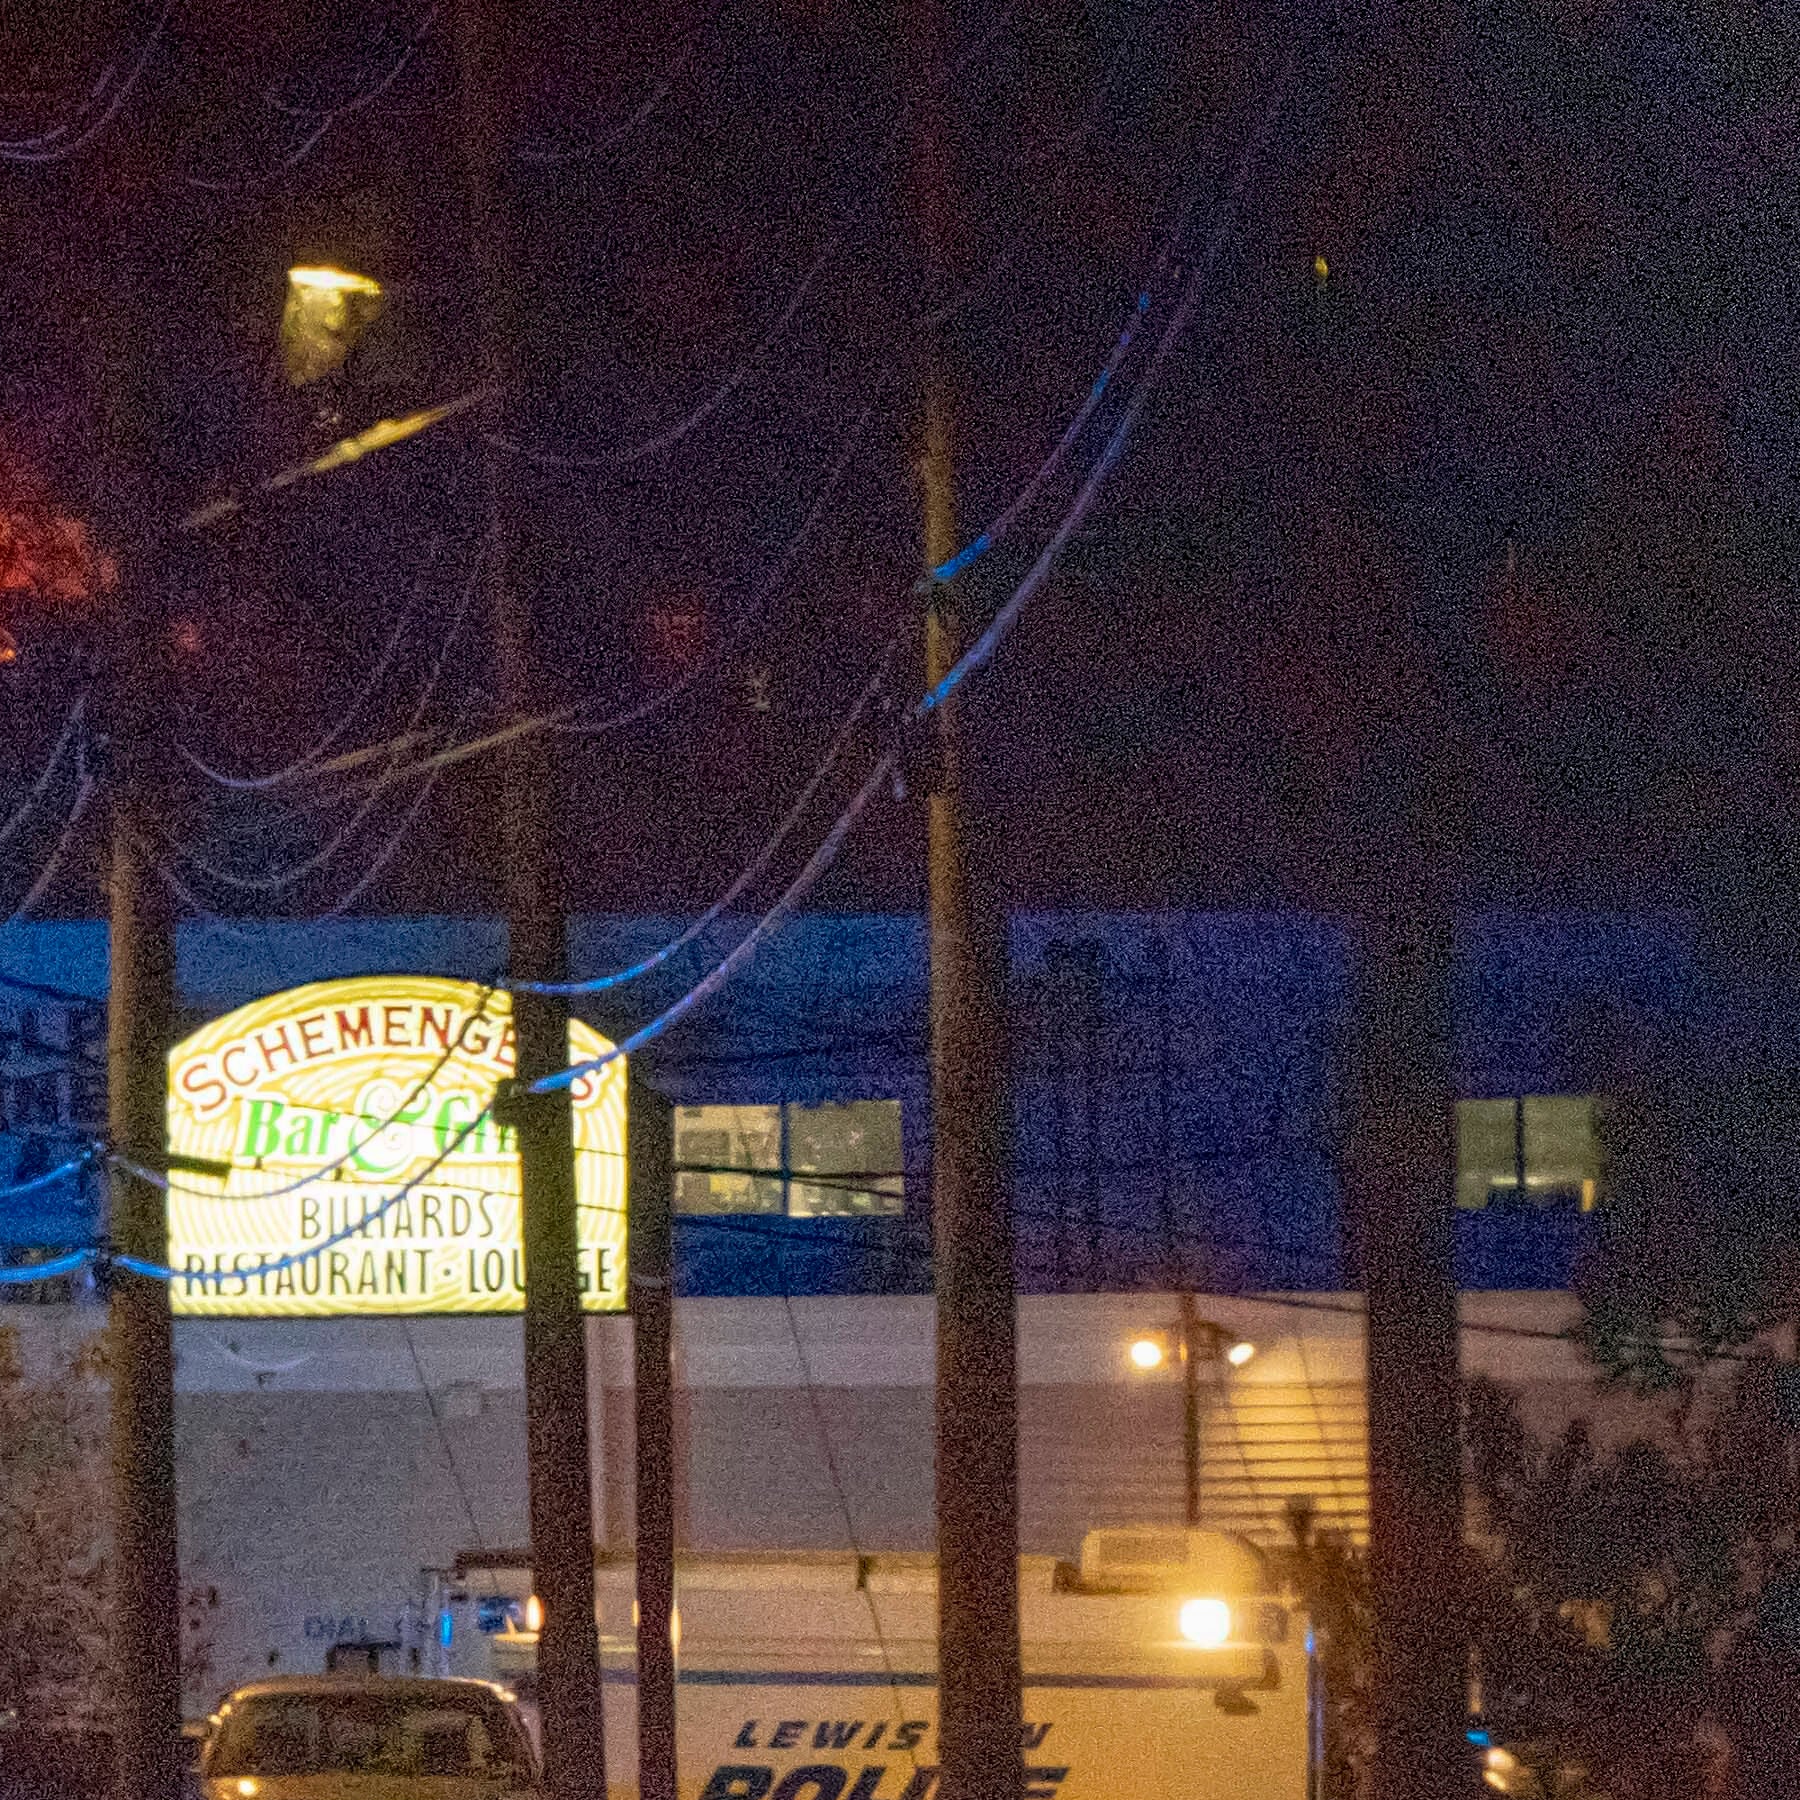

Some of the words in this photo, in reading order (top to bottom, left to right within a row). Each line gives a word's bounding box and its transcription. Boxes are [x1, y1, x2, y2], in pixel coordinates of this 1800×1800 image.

[182, 1005, 609, 1112] SCHEMENGES
[238, 1099, 341, 1157] Bar
[350, 1081, 432, 1174] &
[301, 1193, 495, 1240] BILLIARDS
[185, 1249, 433, 1297] RESTAURANT
[469, 1247, 612, 1293] LOUGE
[734, 1719, 1053, 1750] LEWISN
